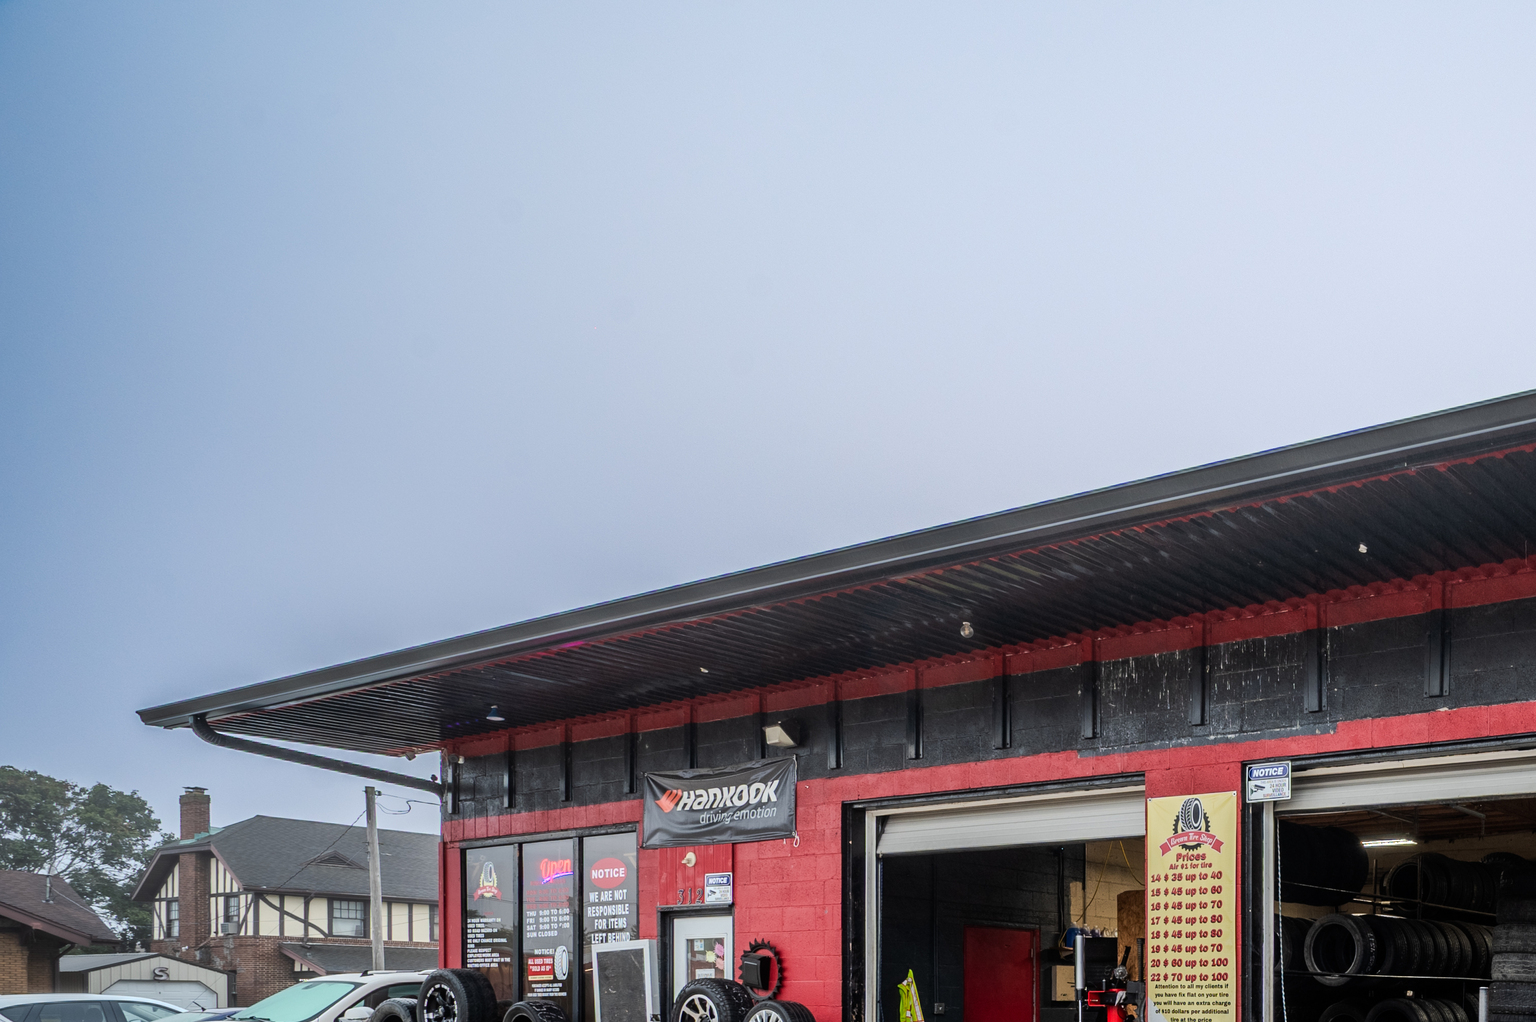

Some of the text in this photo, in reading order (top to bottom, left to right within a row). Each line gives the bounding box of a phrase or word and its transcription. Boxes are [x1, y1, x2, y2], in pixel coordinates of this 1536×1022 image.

[1252, 767, 1284, 778] NOTICE
[700, 805, 777, 824] driving emotion
[1176, 852, 1206, 862] Prices
[540, 858, 572, 883] Open
[592, 868, 625, 879] NOTICE
[1151, 870, 1223, 883] 14 35 up to 40
[589, 889, 627, 902] WE ARE NOT
[677, 888, 703, 905] 312
[1151, 888, 1161, 897] 15
[1171, 887, 1183, 896] 45
[1185, 888, 1196, 897] up
[1199, 886, 1208, 894] to
[588, 904, 629, 917] RESPONSIBLE
[1171, 901, 1183, 910] 45
[1185, 902, 1196, 911] up
[1199, 901, 1208, 909] to
[1210, 900, 1223, 909] 70
[595, 918, 627, 929] FOR ITEMS
[1151, 916, 1161, 926] 17
[1171, 916, 1183, 924] 45
[1185, 917, 1196, 926] up
[1199, 915, 1208, 923] to
[592, 932, 630, 944] LEFT BEHIND
[1171, 930, 1183, 939] 45
[1185, 931, 1196, 940] up
[1199, 930, 1208, 938] to
[1151, 943, 1223, 954] 19 45 up to 70
[1151, 959, 1161, 968] 20
[1185, 960, 1196, 969] up
[1199, 958, 1208, 966] to
[1210, 958, 1229, 967] 100
[1151, 972, 1229, 983] 22 70 up to 100
